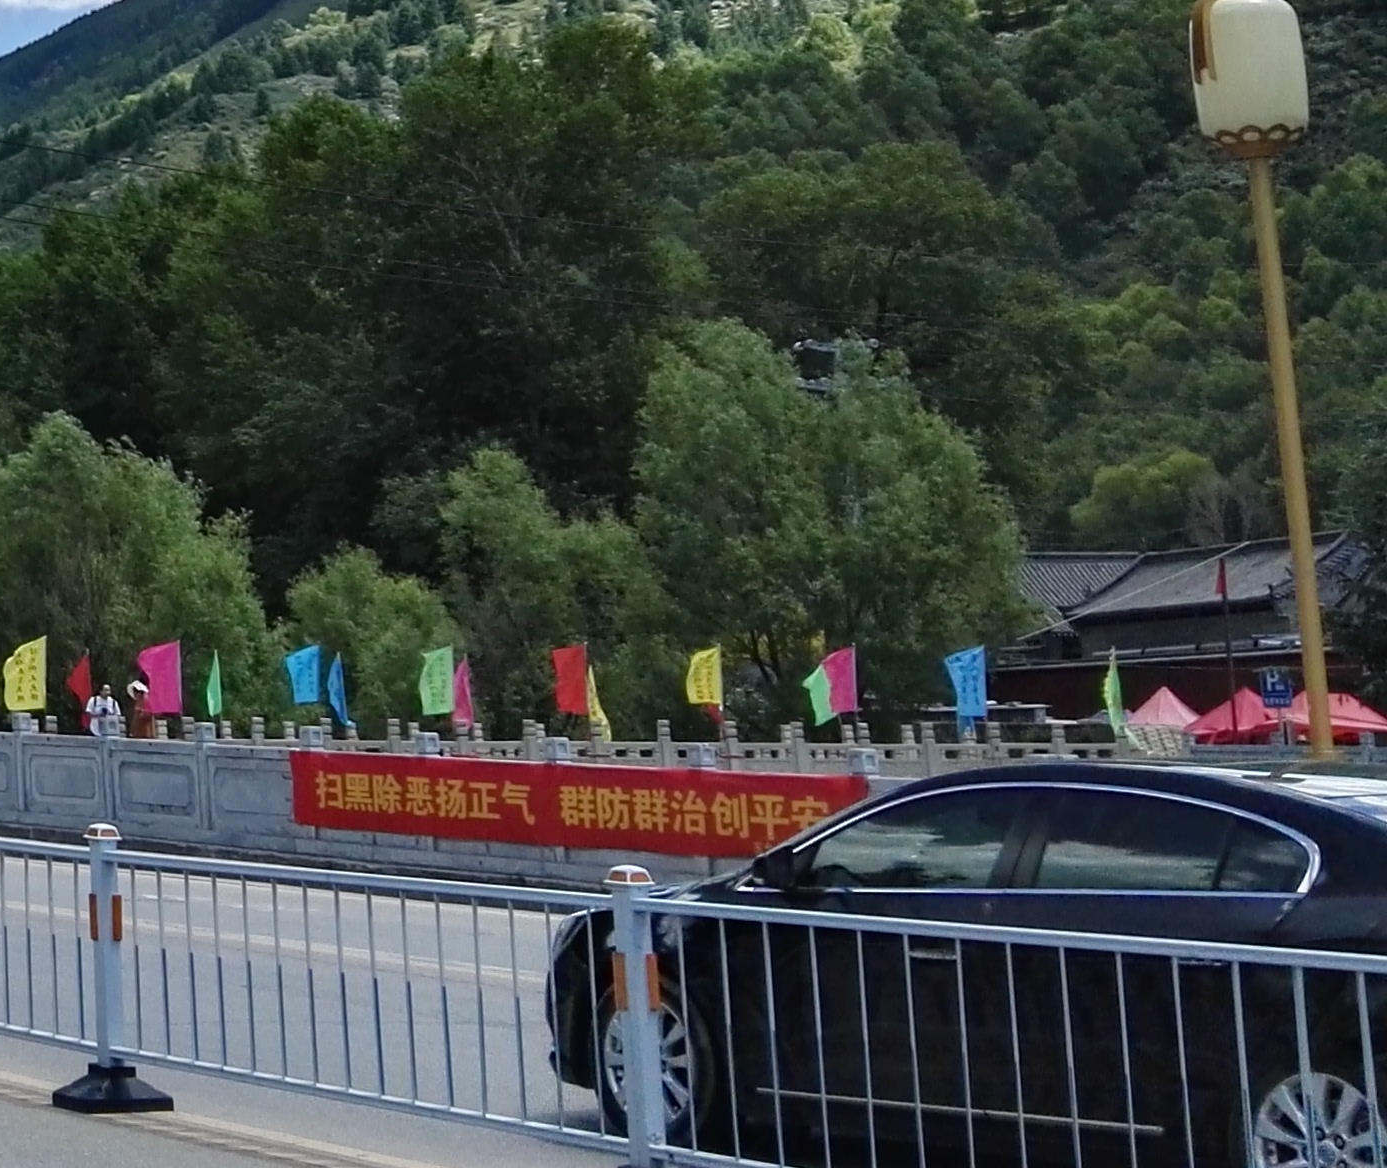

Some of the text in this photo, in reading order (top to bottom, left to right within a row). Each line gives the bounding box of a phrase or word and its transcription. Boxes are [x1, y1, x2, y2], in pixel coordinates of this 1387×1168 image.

[316, 770, 830, 840] 扫黑除恶扬正气 群防群治创平安
